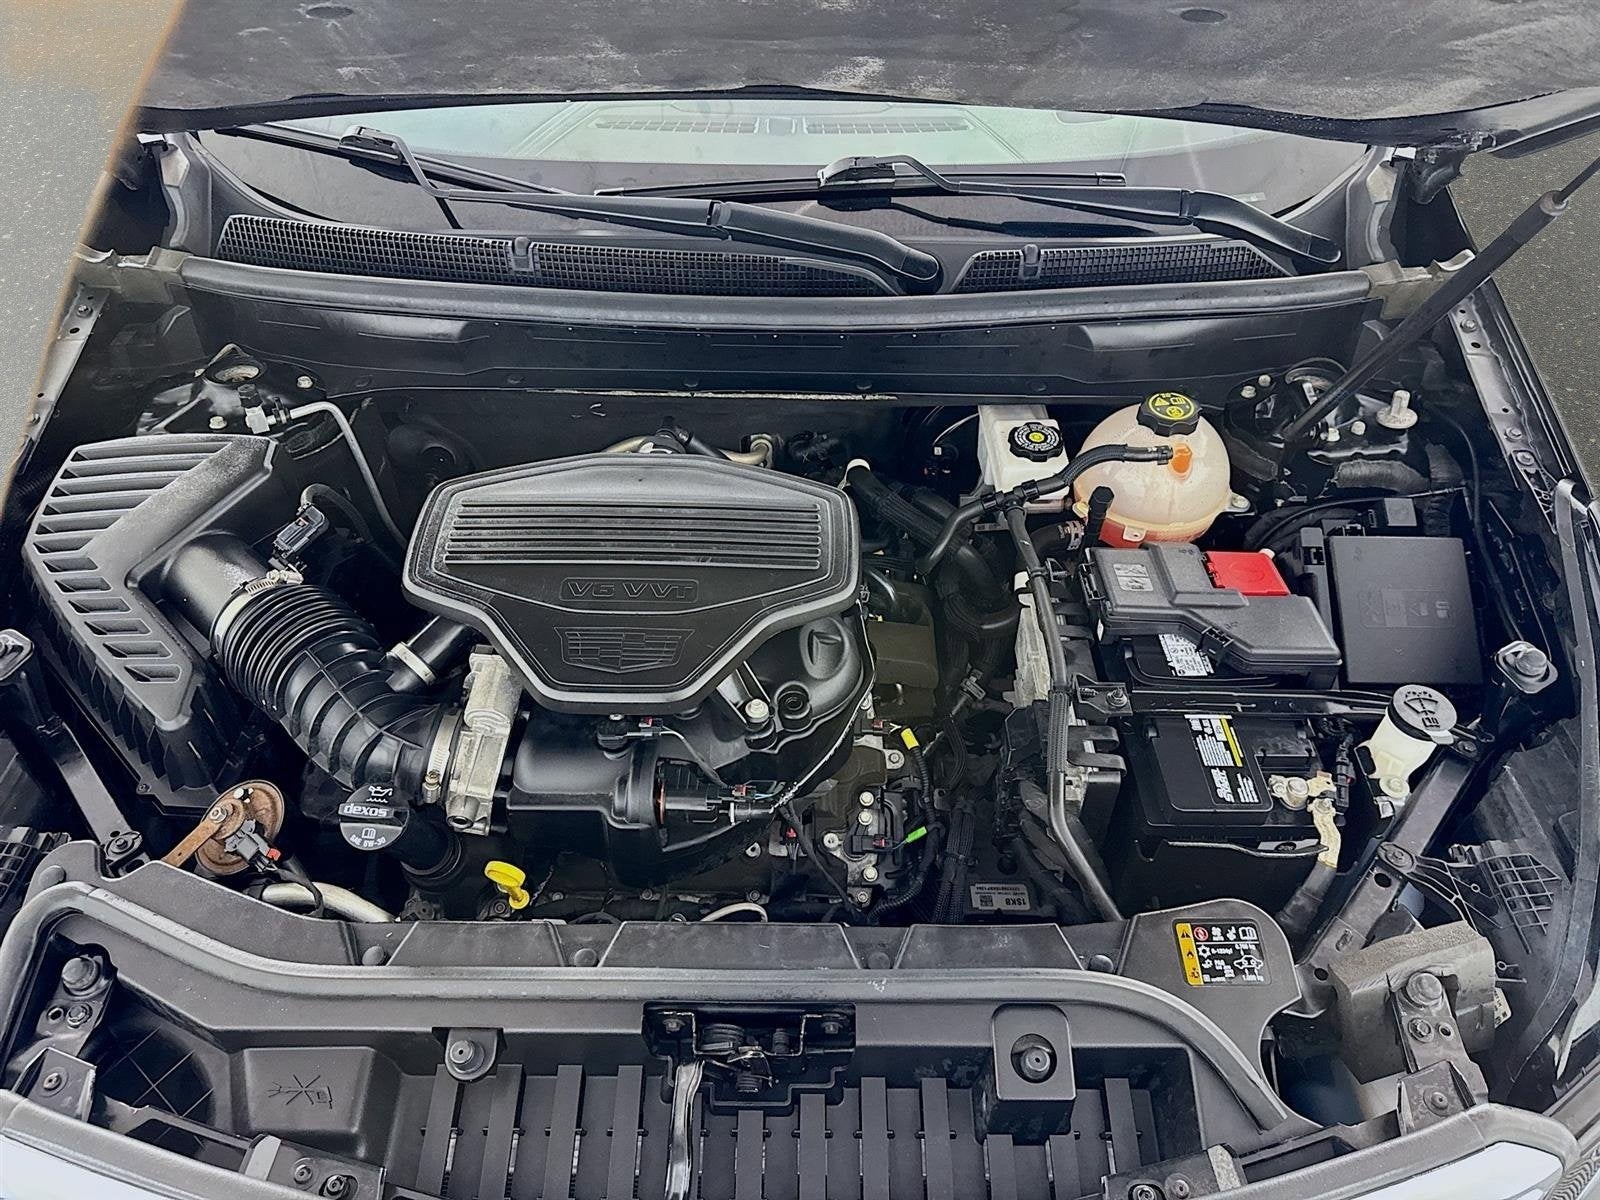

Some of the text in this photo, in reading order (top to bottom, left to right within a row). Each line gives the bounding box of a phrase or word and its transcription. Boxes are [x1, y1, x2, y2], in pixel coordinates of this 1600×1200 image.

[567, 581, 693, 599] V6 VVT
[344, 803, 389, 817] dexos
[350, 835, 362, 845] SAE
